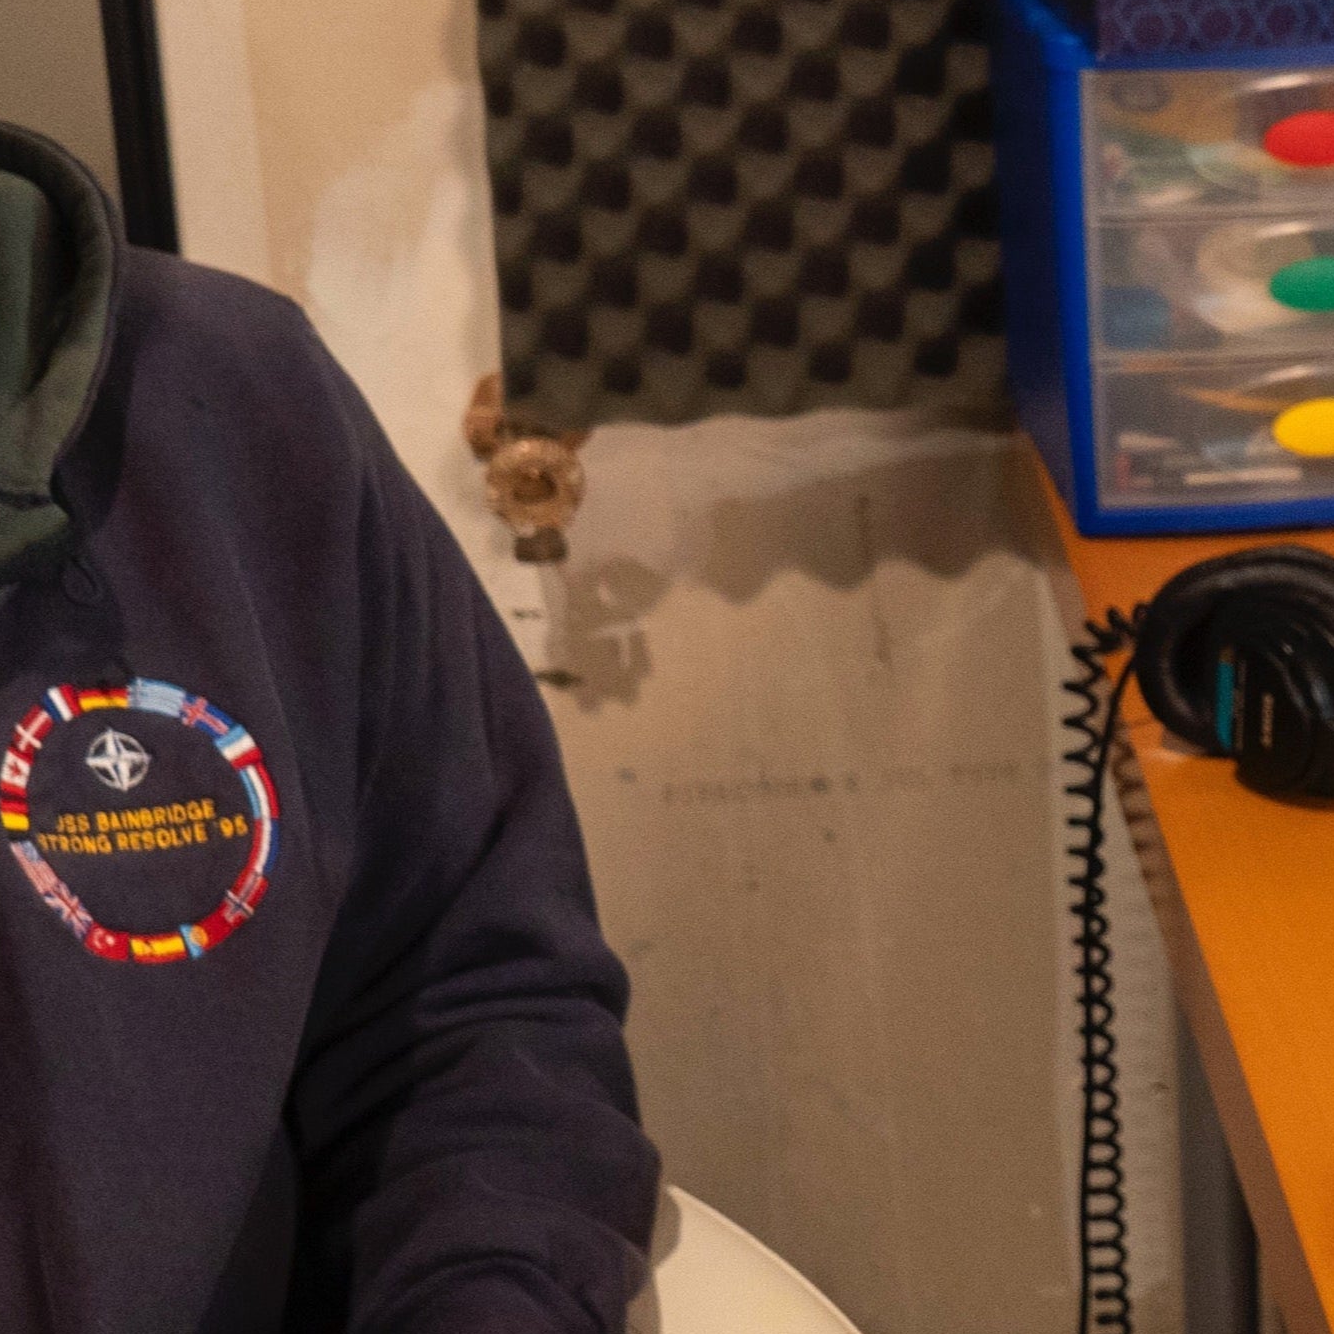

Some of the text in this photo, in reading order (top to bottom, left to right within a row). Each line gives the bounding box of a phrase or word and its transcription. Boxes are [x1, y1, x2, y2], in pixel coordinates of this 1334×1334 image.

[95, 799, 214, 833] BAINBRIDGE
[36, 832, 113, 854] STRONG
[116, 821, 207, 851] RESOLVE
